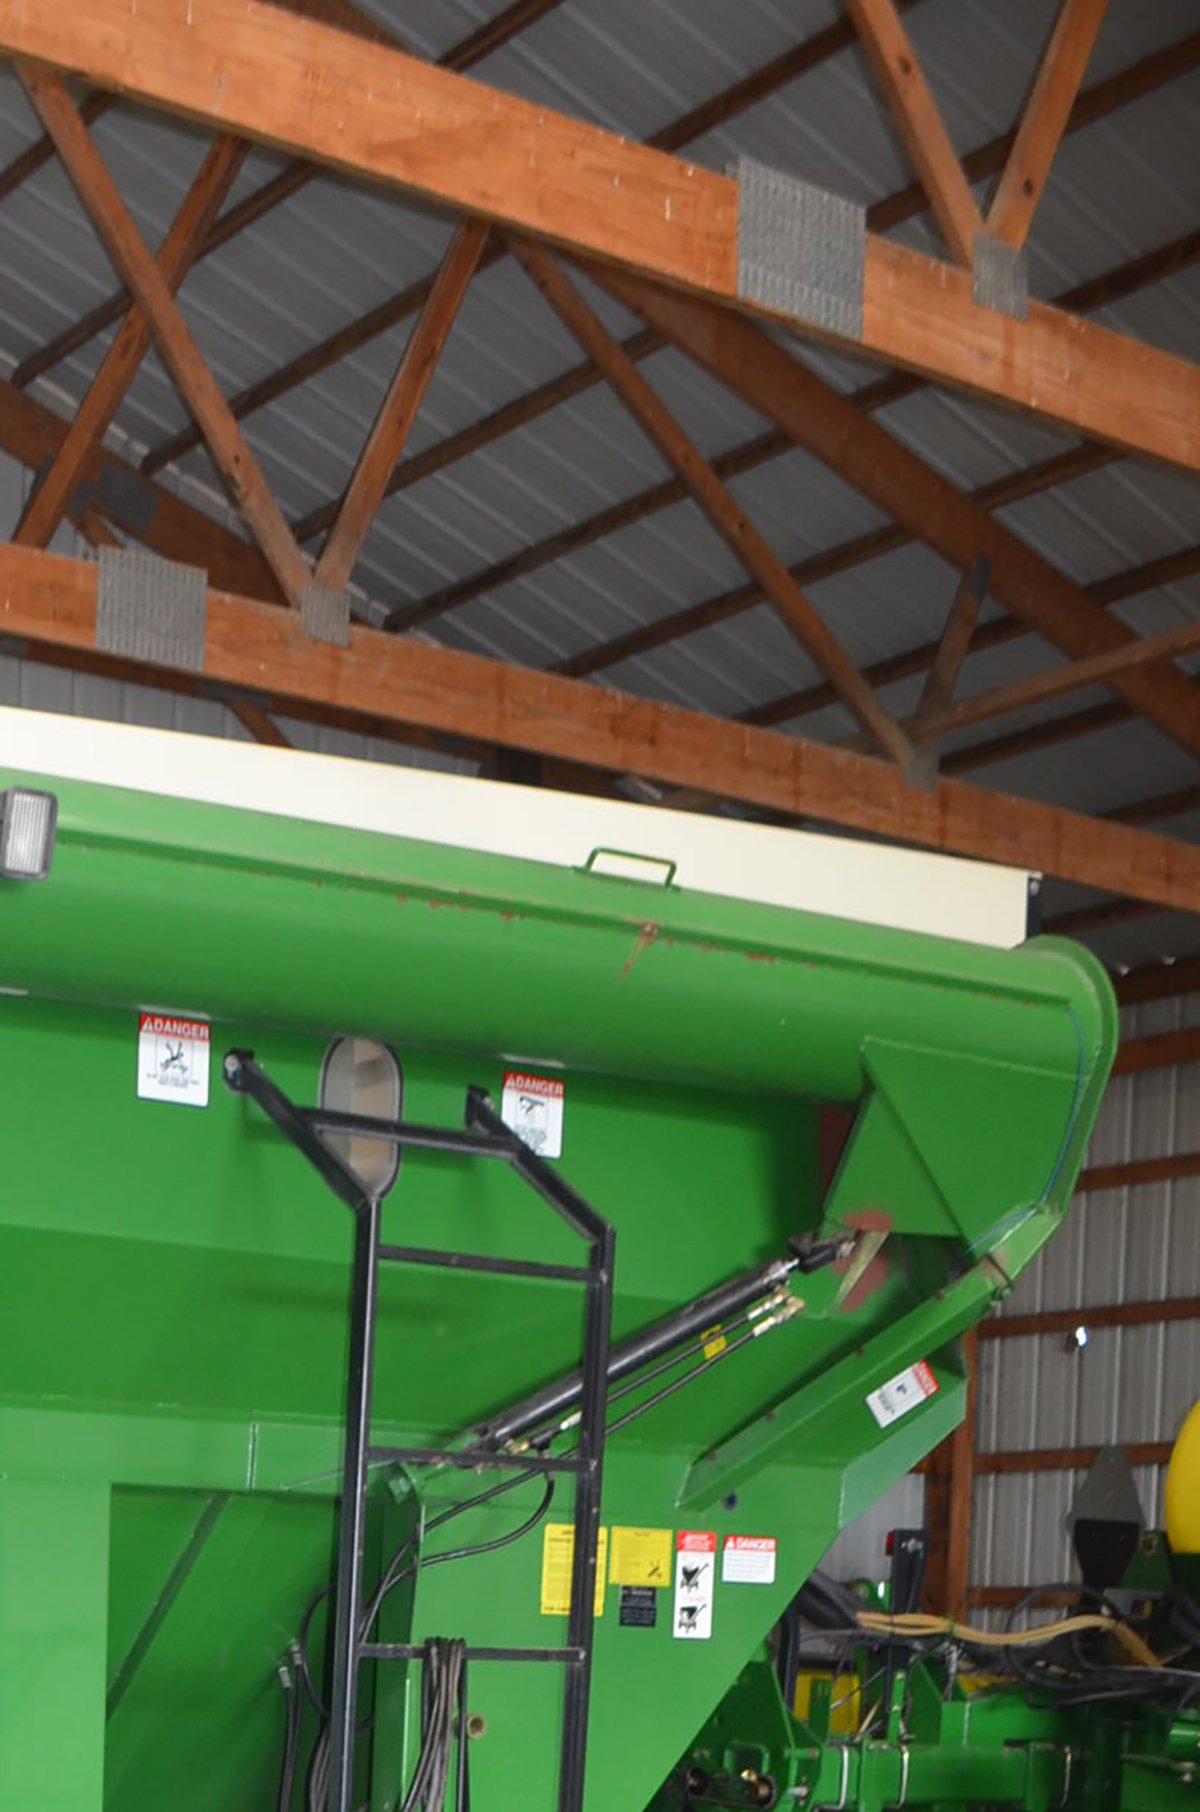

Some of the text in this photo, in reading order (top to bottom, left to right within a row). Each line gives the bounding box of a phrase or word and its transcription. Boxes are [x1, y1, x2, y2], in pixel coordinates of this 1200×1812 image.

[154, 1017, 210, 1040] DANGER
[516, 1074, 564, 1096] DANGER
[736, 1537, 776, 1551] DANGER
